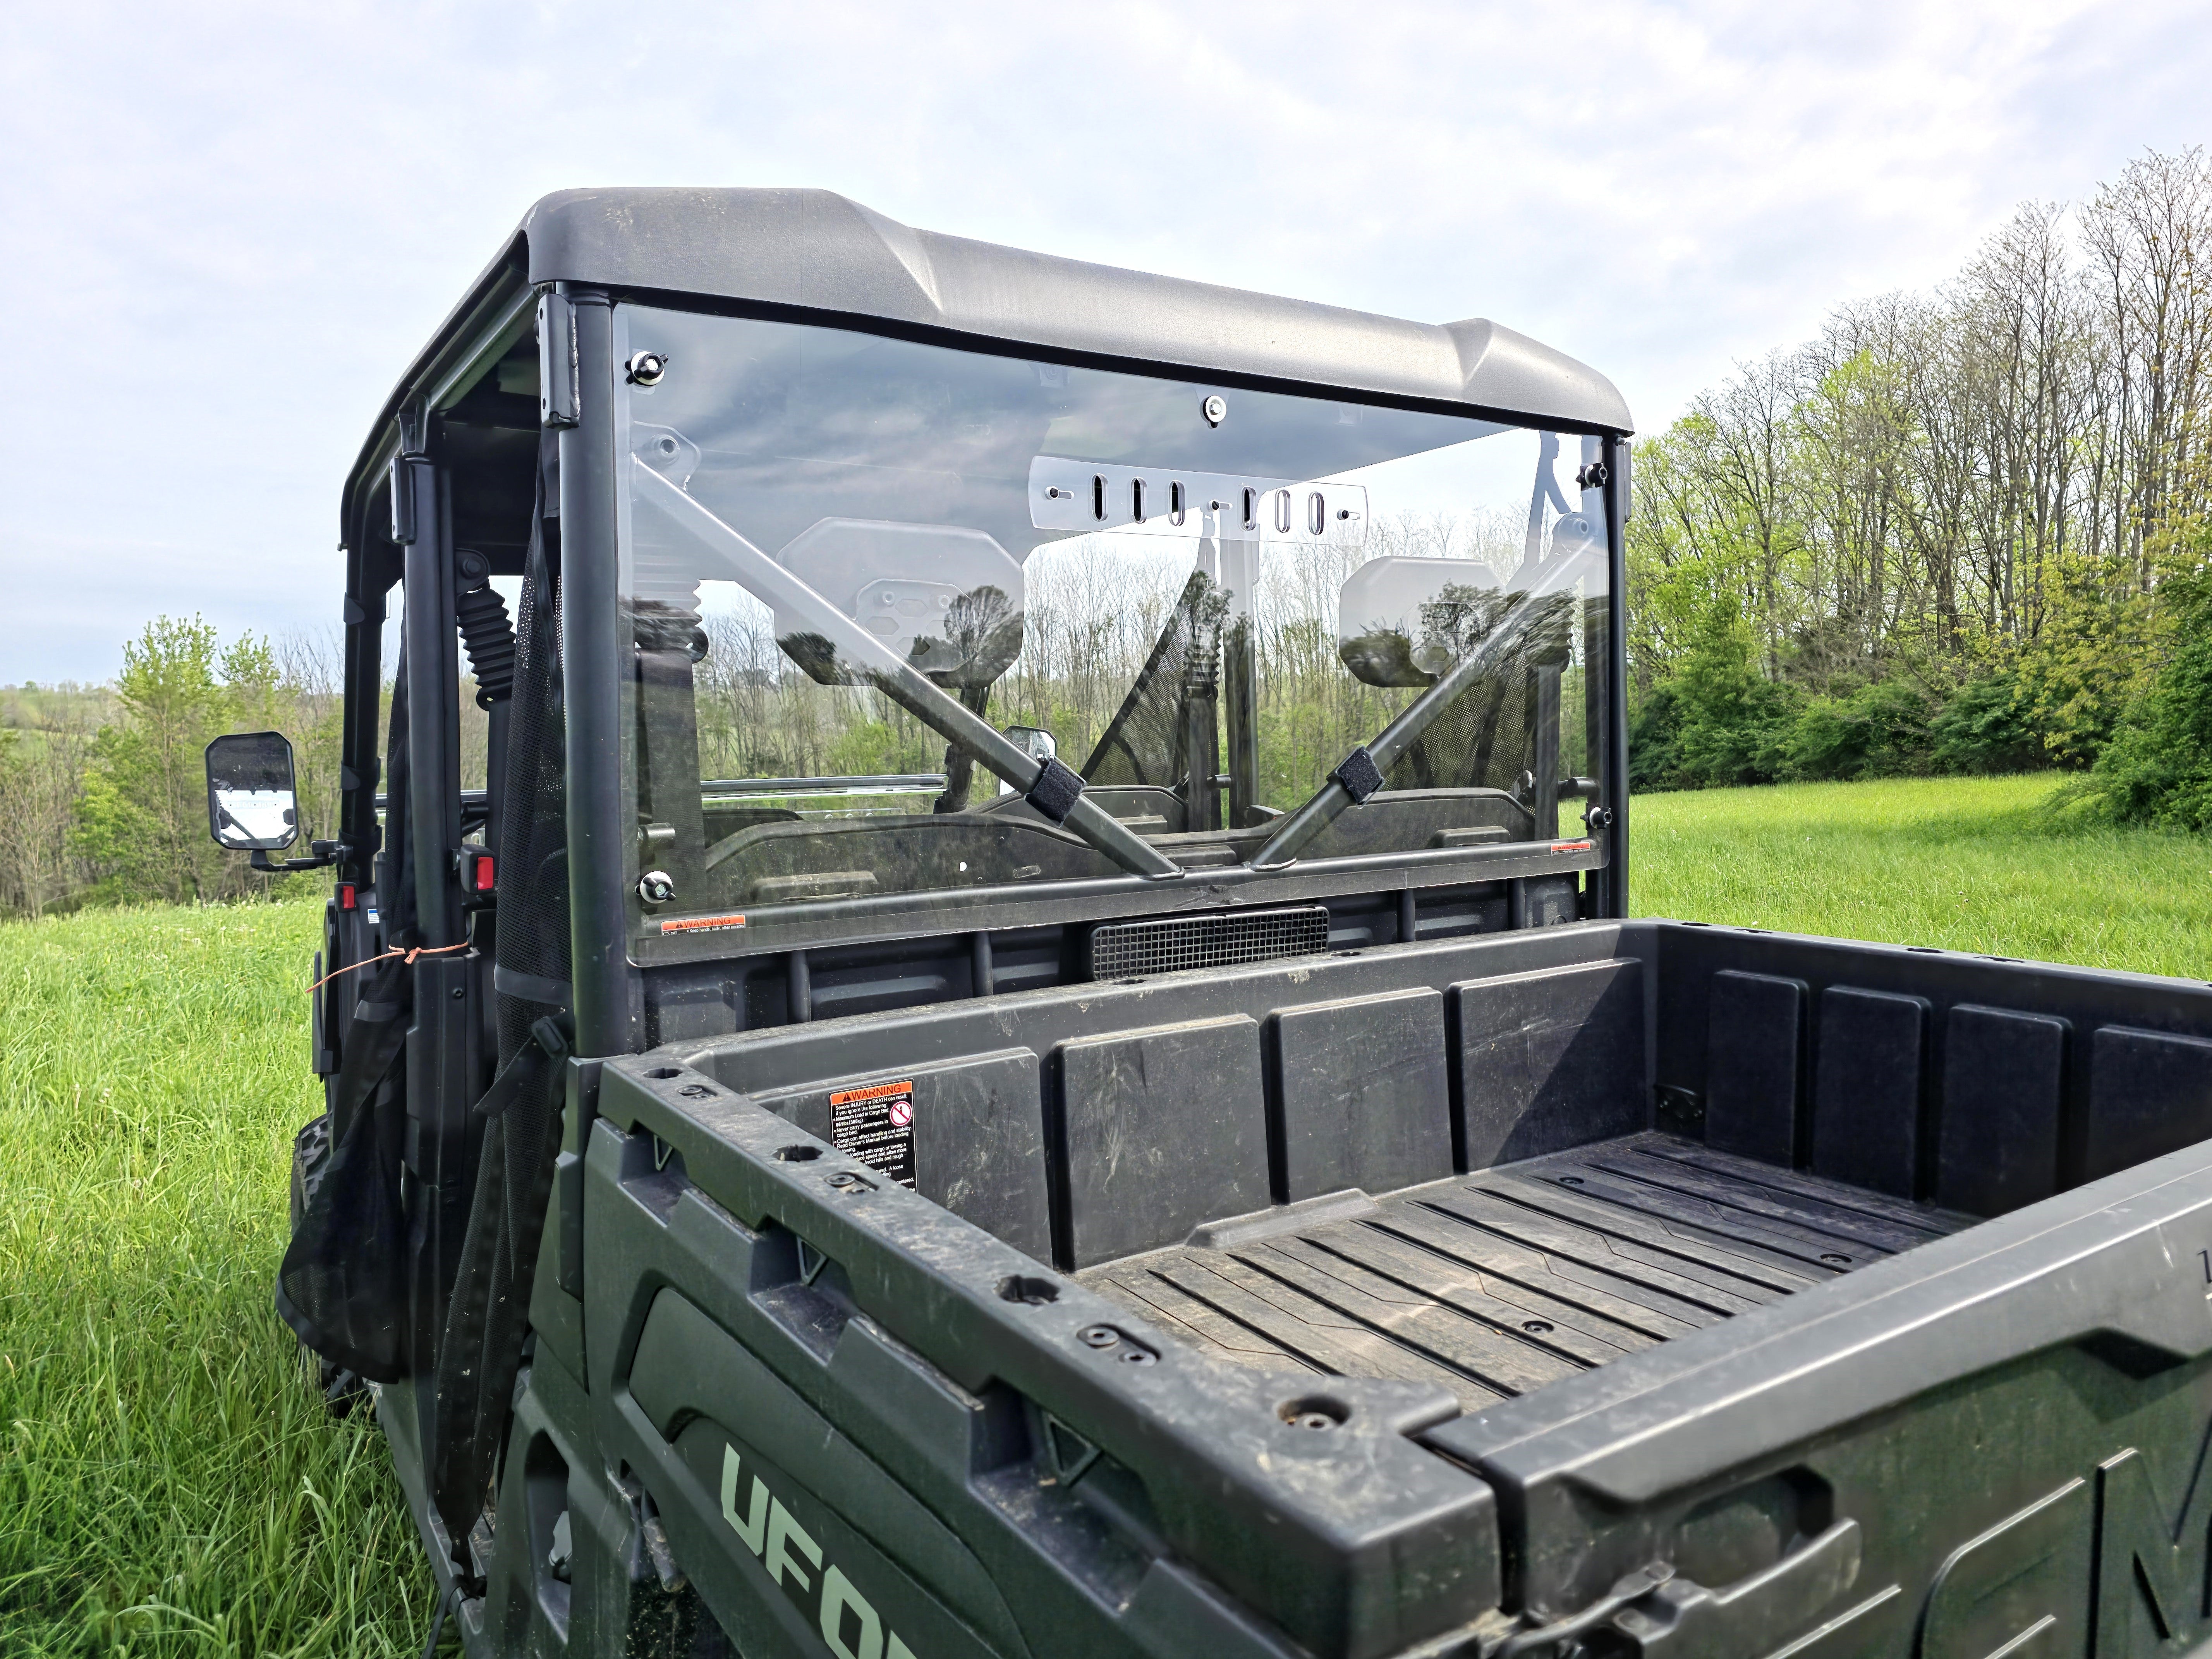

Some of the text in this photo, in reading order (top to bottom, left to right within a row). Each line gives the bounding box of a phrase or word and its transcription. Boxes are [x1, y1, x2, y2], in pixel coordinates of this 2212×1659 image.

[684, 917, 731, 928] WARNING
[851, 1084, 901, 1100] WARNING
[860, 1120, 884, 1129] passengers
[721, 1442, 917, 1659] UFO
